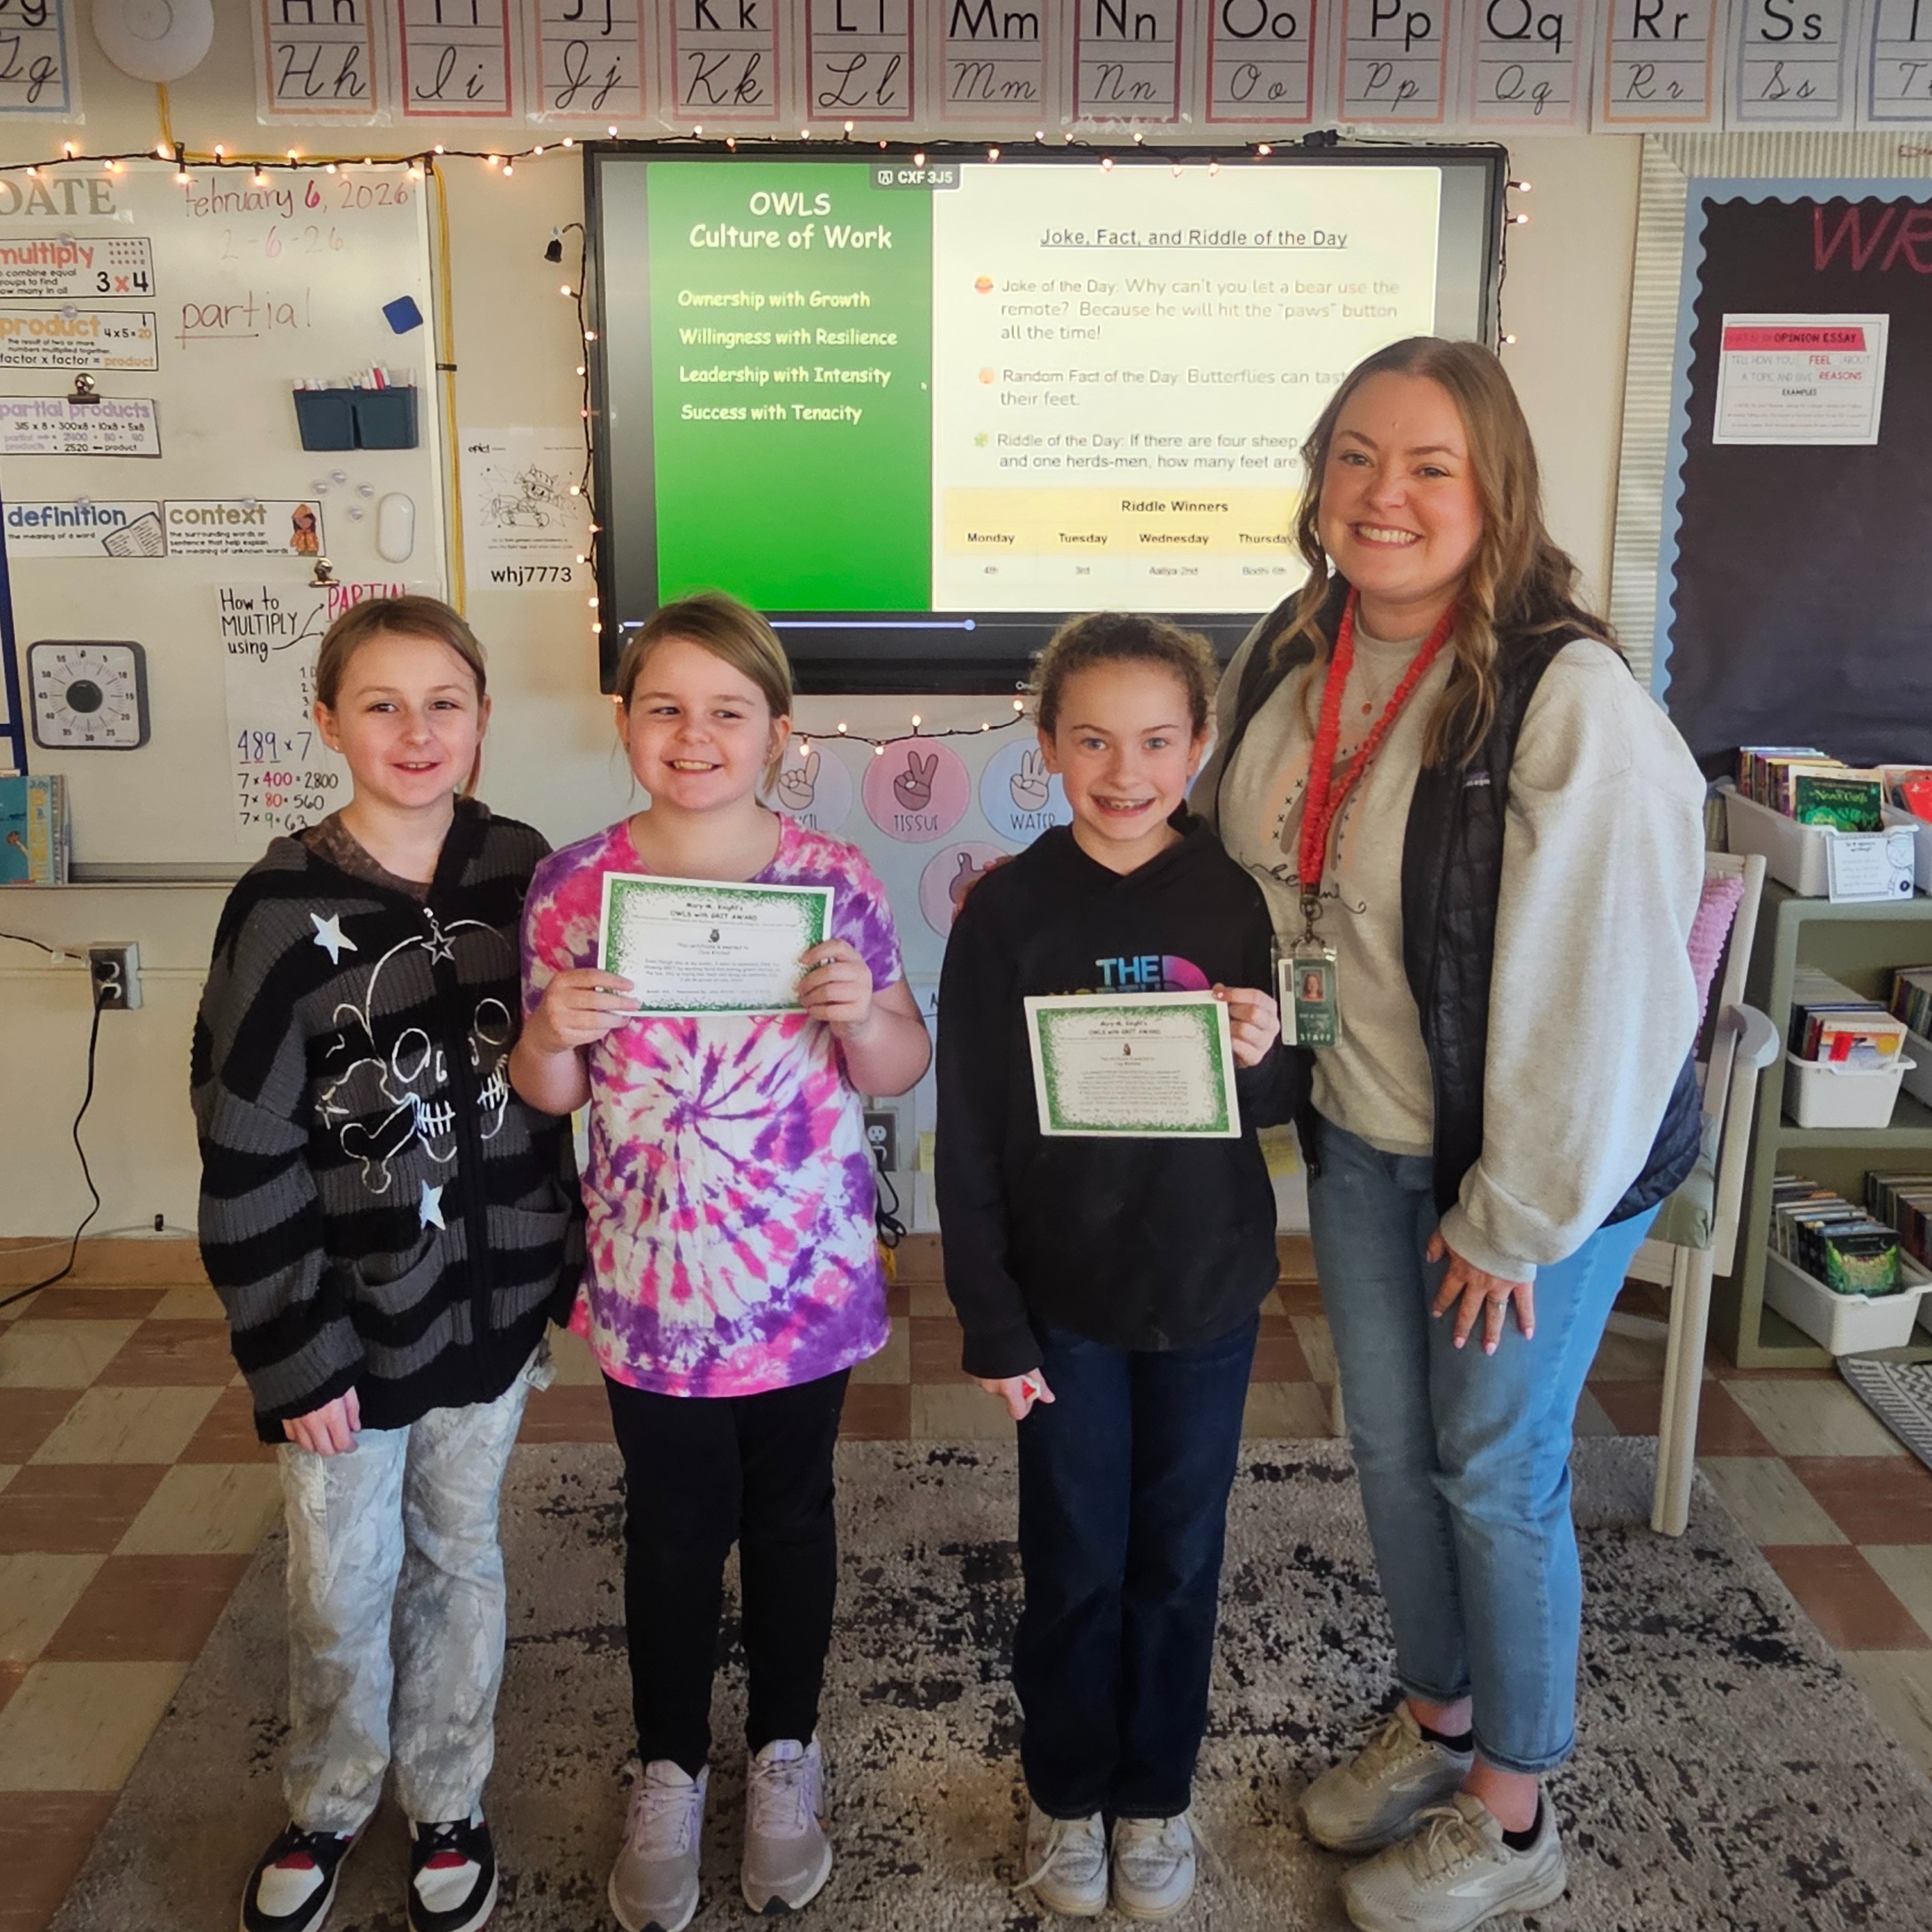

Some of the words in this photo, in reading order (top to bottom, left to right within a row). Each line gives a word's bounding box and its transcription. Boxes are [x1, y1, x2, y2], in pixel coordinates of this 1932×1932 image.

[949, 0, 1039, 40] Mm
[1096, 0, 1157, 38] Nn
[1222, 0, 1296, 38] Oo
[1371, 0, 1431, 53] Pp
[1486, 0, 1563, 55] Qq
[1632, 0, 1688, 40] Rr
[1761, 0, 1822, 42] Ss
[897, 170, 925, 184] CXF
[927, 171, 953, 184] 3J5
[185, 177, 294, 219] February
[338, 181, 409, 210] 2026
[749, 191, 831, 217] OWLS
[689, 223, 781, 248] Culture
[788, 224, 815, 250] of
[824, 225, 893, 249] Work
[1040, 229, 1090, 246] Joke,
[1096, 229, 1141, 247] Fact,
[1148, 230, 1182, 246] and
[1189, 230, 1248, 246] Riddle
[1254, 230, 1273, 246] of
[1278, 231, 1306, 246] the
[1313, 231, 1348, 249] Day
[96, 271, 111, 293] 3
[133, 270, 149, 293] 4
[1001, 279, 1036, 293] Joke
[1041, 279, 1055, 293] of
[1059, 279, 1082, 293] the
[1125, 278, 1167, 296] Why
[1171, 278, 1211, 293] can't
[1216, 281, 1247, 295] you
[1253, 279, 1274, 293] let
[1295, 279, 1331, 293] bear
[1337, 283, 1367, 294] use
[1373, 280, 1400, 294] the
[678, 290, 765, 311] Ownership
[769, 291, 805, 307] with
[809, 291, 870, 307] Growth
[1000, 302, 1069, 316] remote?
[1079, 302, 1150, 316] Because
[1156, 302, 1176, 317] he
[1182, 302, 1213, 317] will
[1218, 303, 1239, 317] hit
[1245, 303, 1272, 317] the
[1342, 304, 1397, 318] button
[0, 315, 100, 339] product
[182, 287, 311, 349] partial
[104, 328, 112, 338] 4
[122, 328, 130, 338] 5
[678, 328, 771, 349] Willingness
[775, 328, 811, 345] with
[816, 328, 898, 346] Resilience
[1001, 325, 1021, 339] all
[1027, 325, 1054, 339] the
[1060, 325, 1101, 340] time!
[0, 354, 37, 364] factor
[52, 355, 89, 365] factor
[104, 356, 154, 367] product
[1808, 355, 1832, 365] FEEL
[680, 366, 770, 386] Leadership
[773, 366, 809, 383] with
[813, 367, 891, 387] Intensity
[1003, 369, 1064, 383] Random
[1069, 369, 1100, 383] Fact
[1104, 369, 1119, 383] of
[1122, 370, 1145, 384] the
[1187, 369, 1275, 384] Butterflies
[1280, 372, 1310, 384] can
[1818, 371, 1862, 380] REASONS
[1000, 391, 1039, 405] their
[1044, 391, 1080, 406] feet.
[0, 401, 63, 420] partial
[69, 401, 150, 420] products
[681, 404, 747, 421] Success
[751, 404, 787, 421] with
[791, 404, 863, 424] Tenacity
[997, 433, 1043, 447] Riddle
[1047, 434, 1062, 448] of
[1065, 434, 1088, 448] the
[1144, 434, 1183, 448] there
[1187, 437, 1212, 448] are
[1217, 434, 1247, 448] four
[999, 454, 1028, 467] and
[1032, 457, 1061, 467] one
[1066, 455, 1151, 470] herds-men,
[1157, 455, 1189, 468] how
[1194, 457, 1235, 471] many
[1240, 455, 1268, 468] feet
[1273, 457, 1298, 468] are
[7, 505, 126, 528] definition
[169, 504, 268, 525] context
[1121, 501, 1166, 512] Riddle
[1171, 501, 1228, 513] Winners
[967, 532, 1015, 545] Monday
[1058, 532, 1108, 545] Tuesday
[1139, 534, 1209, 546] Wednesday
[491, 566, 573, 587] whj7773
[220, 587, 254, 612] How
[261, 586, 279, 611] to
[221, 611, 298, 637] MULTIPLY
[228, 639, 270, 663] using
[237, 729, 279, 762] 489
[297, 731, 311, 762] 7
[237, 773, 250, 789] 7
[262, 771, 293, 787] 400
[304, 773, 338, 790] 2800
[240, 793, 250, 808] 7
[265, 793, 283, 808] 80
[293, 794, 325, 810] 560
[240, 812, 250, 826] 7
[265, 811, 274, 828] 9
[893, 814, 939, 831] TISSUE
[1010, 813, 1056, 831] WATER
[1095, 955, 1159, 986] THE
